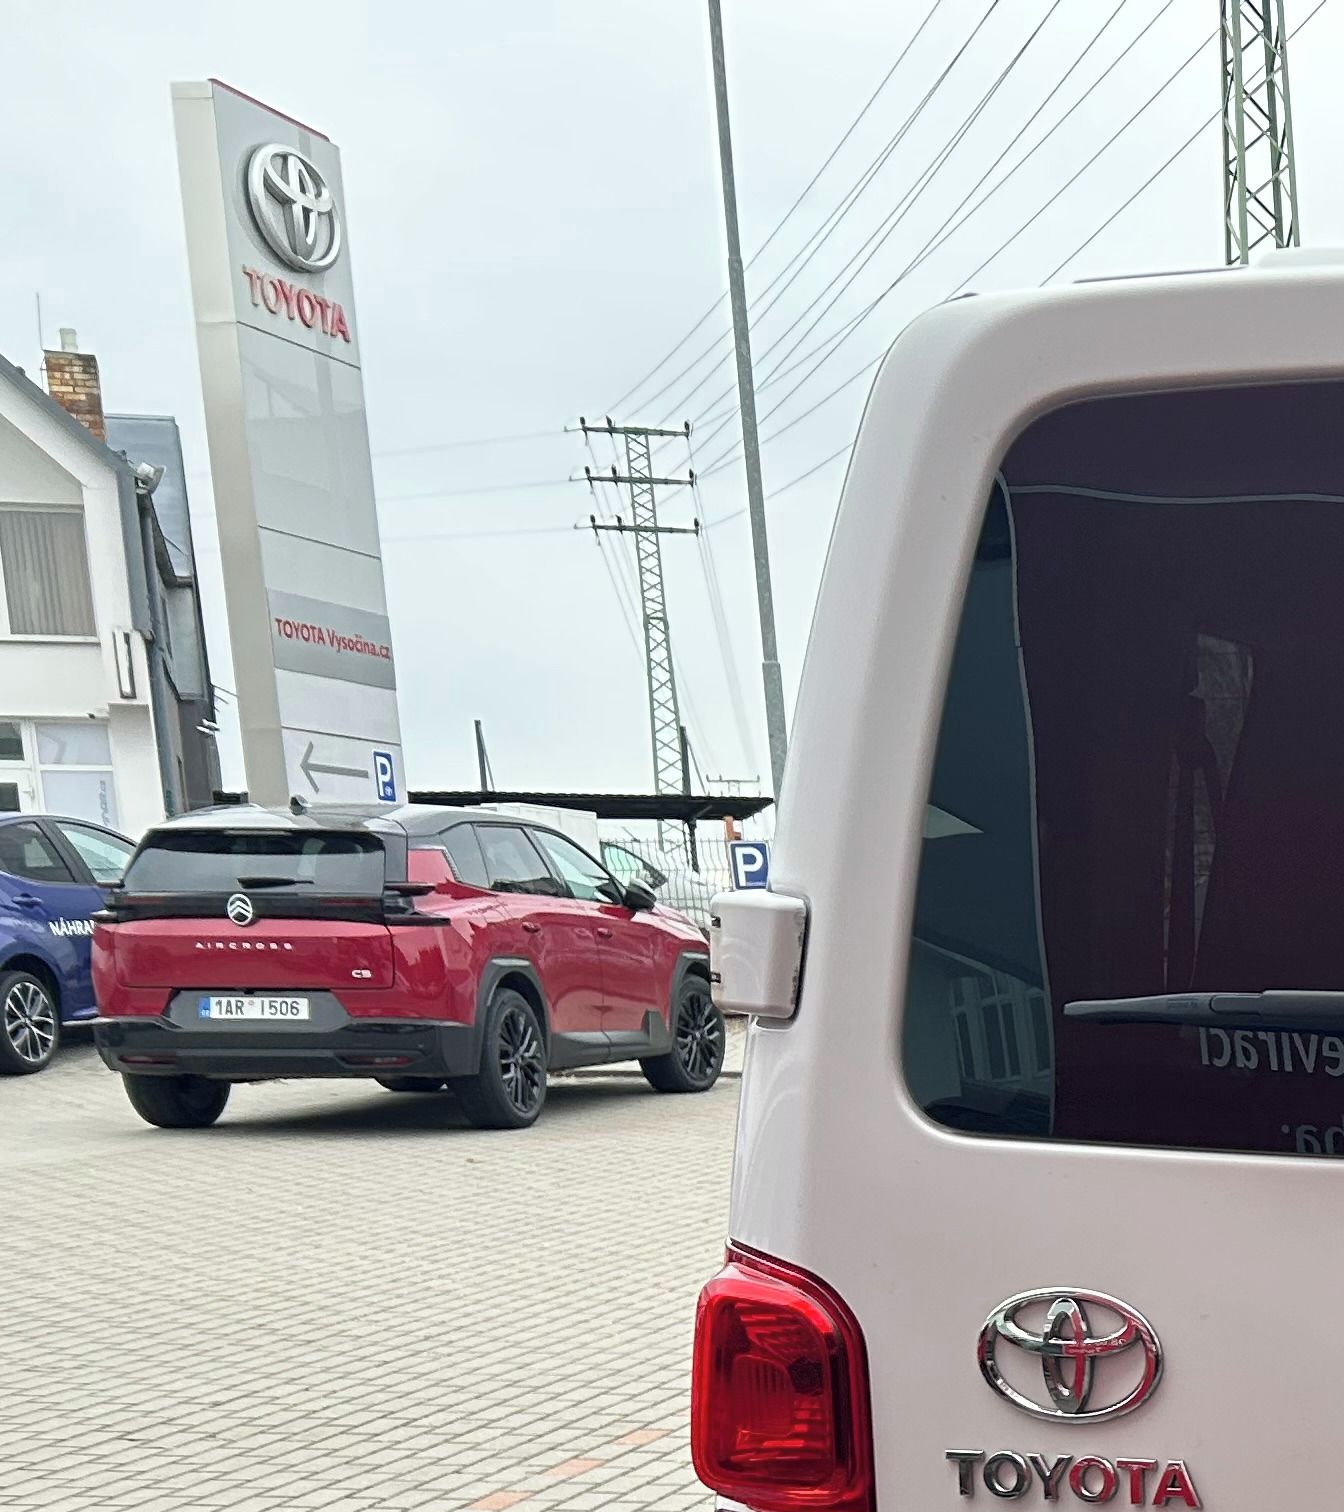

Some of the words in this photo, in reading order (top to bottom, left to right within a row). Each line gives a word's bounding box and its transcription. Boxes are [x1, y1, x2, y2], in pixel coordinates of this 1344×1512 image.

[242, 264, 351, 343] TOYOTA
[275, 618, 325, 645] TOYOTA
[376, 755, 391, 797] P
[735, 847, 764, 887] P
[215, 1000, 245, 1016] 1AR
[945, 1449, 1203, 1509] TOYOTA
